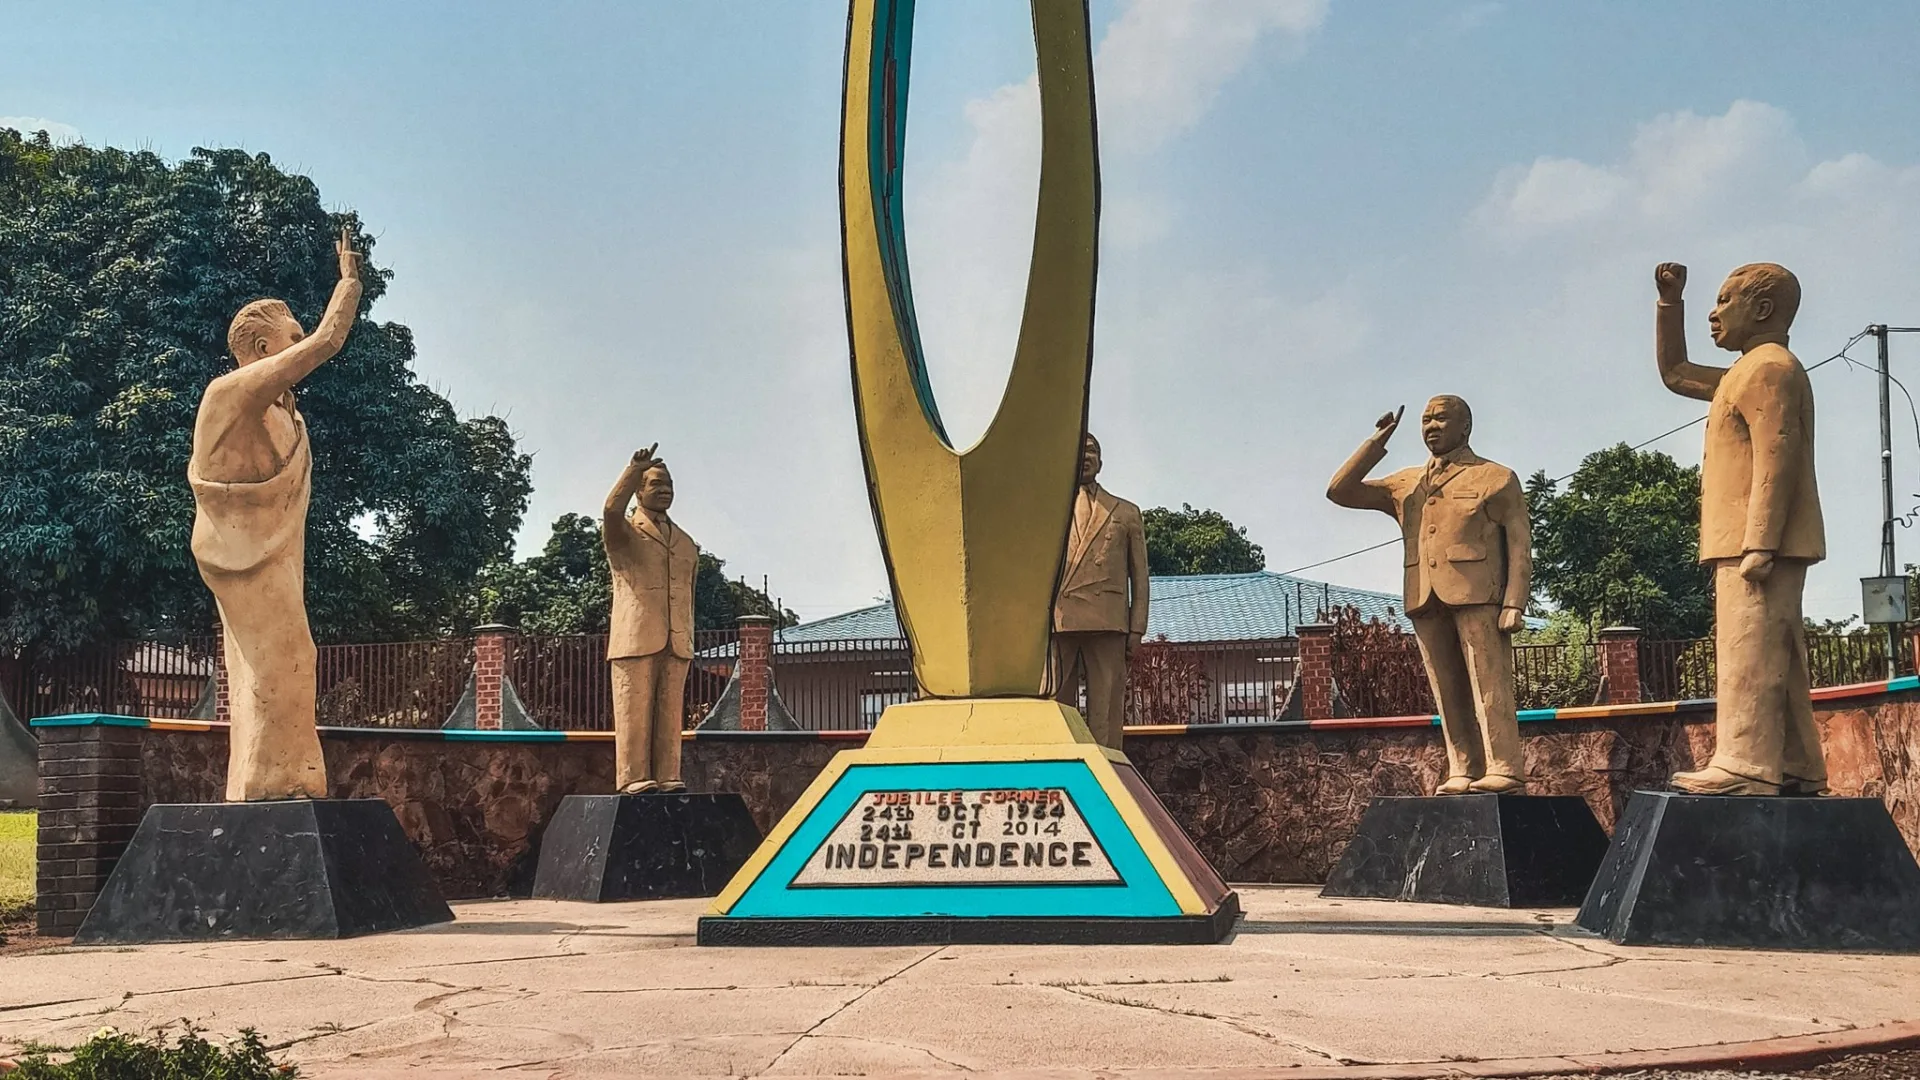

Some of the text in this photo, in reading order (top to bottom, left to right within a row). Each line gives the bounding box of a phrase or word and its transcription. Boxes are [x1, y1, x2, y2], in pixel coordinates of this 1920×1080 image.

[873, 791, 1063, 805] JUBILEE CORNER
[938, 803, 983, 820] OCT
[1008, 802, 1065, 820] 1964
[1002, 822, 1061, 836] 2014
[825, 842, 1093, 869] INDEPENDENCE
